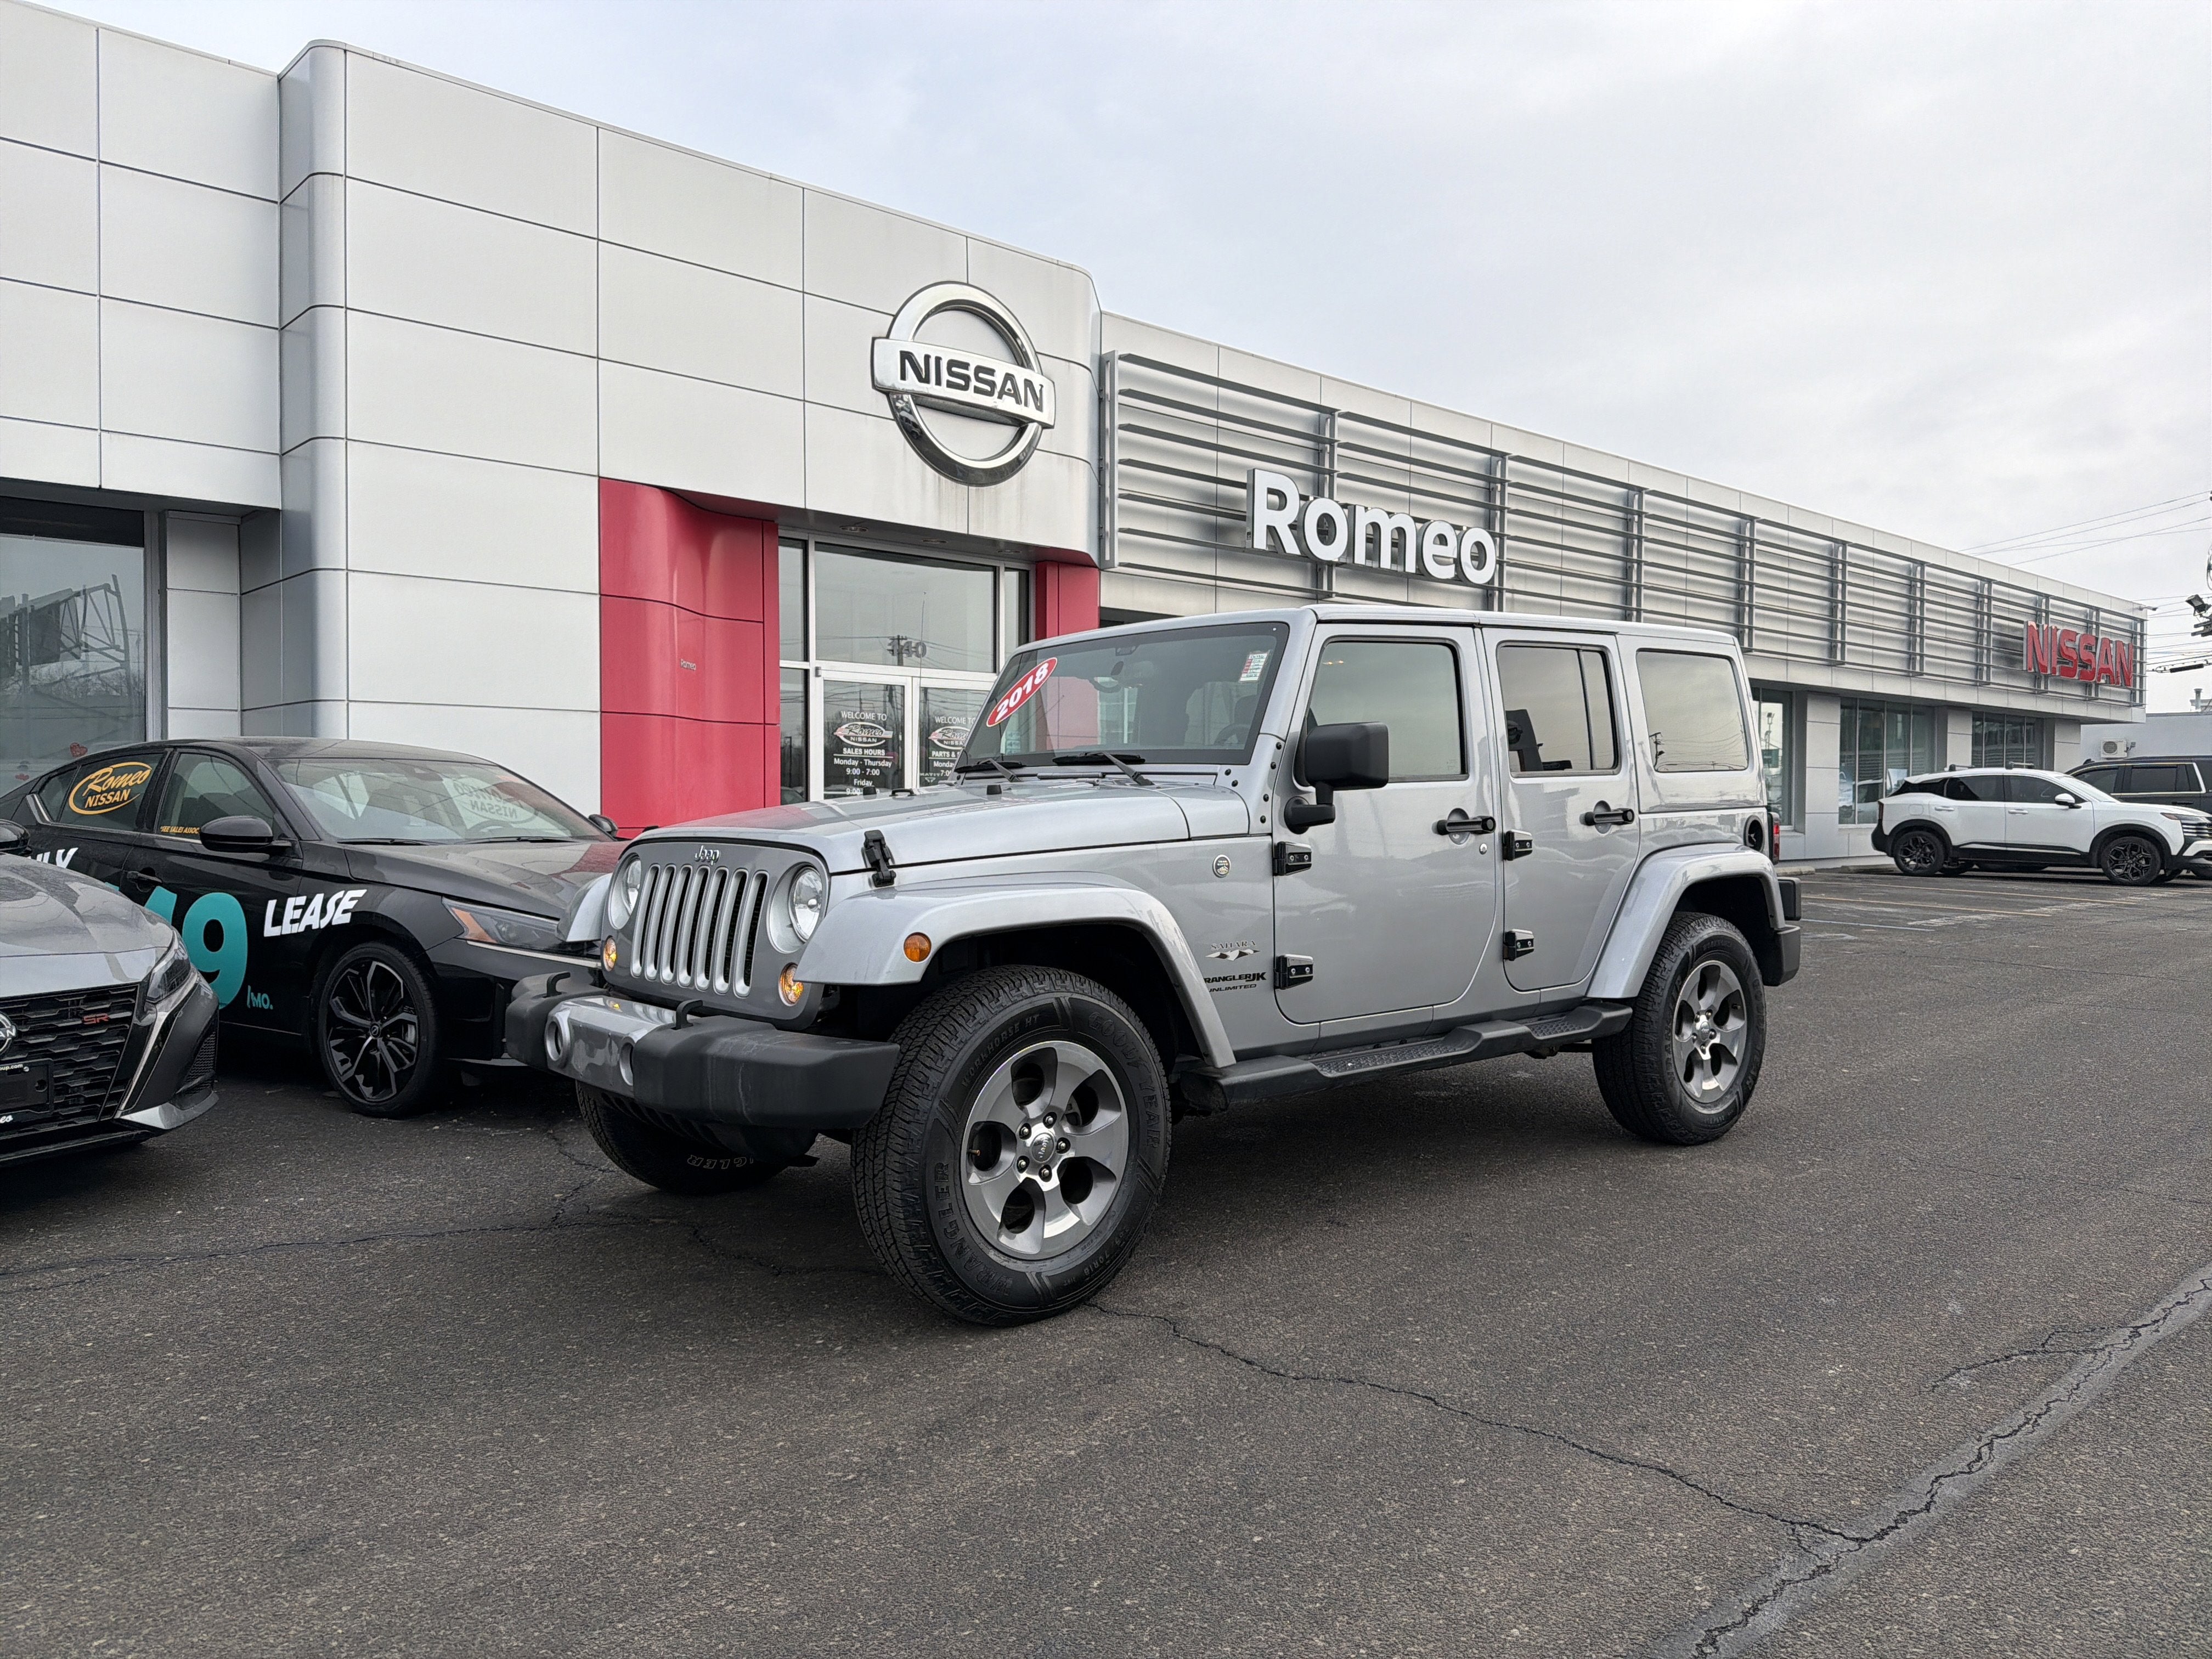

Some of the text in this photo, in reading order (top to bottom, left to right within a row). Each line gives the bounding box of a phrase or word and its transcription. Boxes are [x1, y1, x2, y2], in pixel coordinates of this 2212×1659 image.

[899, 349, 1043, 413] NISSAN
[1247, 468, 1496, 585] Romeo
[2024, 620, 2133, 688] NISSAN
[995, 663, 1048, 723] 2018
[841, 711, 887, 721] WELCOME TO
[935, 716, 966, 724] WELCOME
[847, 723, 884, 736] Romeo
[843, 747, 862, 755] SALES
[834, 758, 859, 767] Monday
[864, 759, 892, 768] Thursday
[866, 768, 880, 776] 7:00
[82, 766, 152, 797] Romeo
[854, 778, 873, 787] Friday
[84, 788, 131, 808] NISSAN
[695, 845, 720, 866] Jeep
[263, 889, 368, 937] LEASE
[1211, 940, 1256, 950] SAHARA
[83, 1013, 109, 1025] SR
